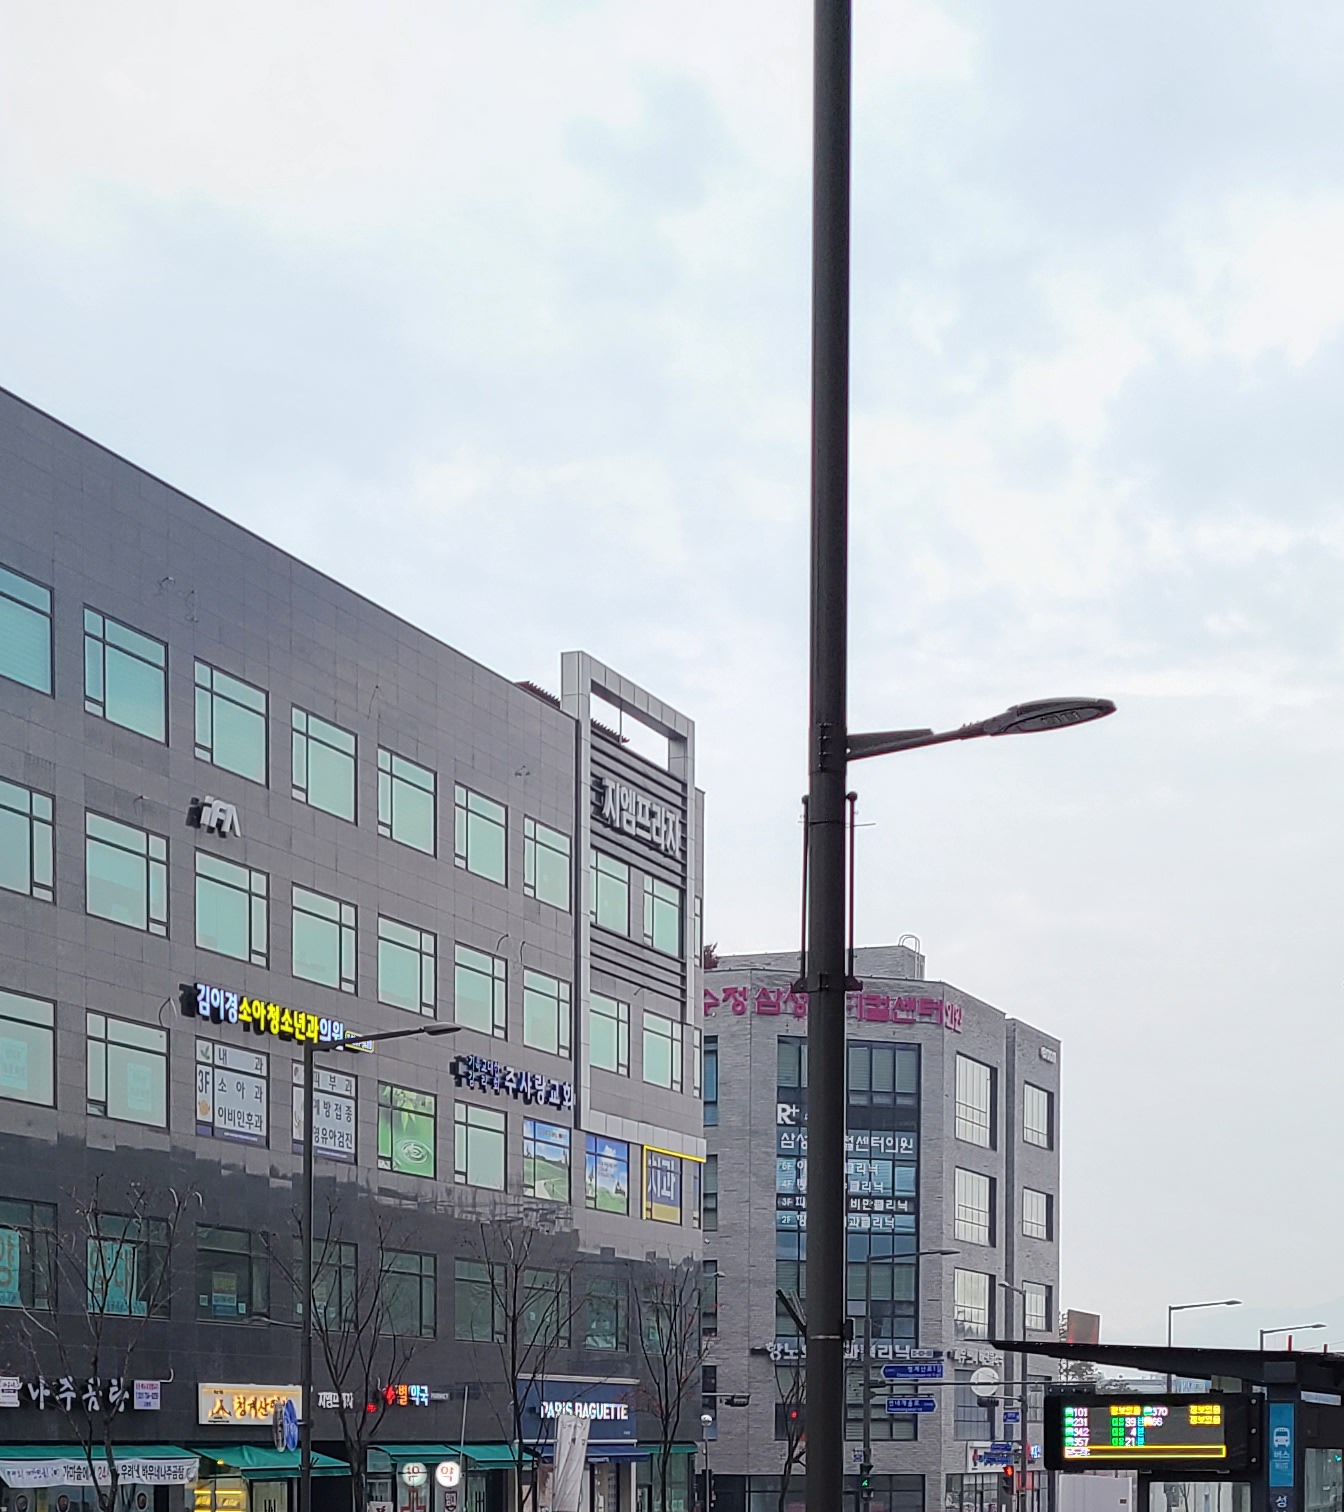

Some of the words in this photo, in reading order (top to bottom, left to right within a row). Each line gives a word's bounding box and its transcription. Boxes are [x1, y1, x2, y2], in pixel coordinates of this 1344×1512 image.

[602, 779, 681, 857] 지엠프라자
[197, 983, 344, 1044] 김이경소아청소년과의원
[198, 1070, 211, 1096] 3F
[505, 1066, 574, 1107] 주사랑교회
[217, 1106, 264, 1132] 이비인후과
[647, 1158, 676, 1201] 치과
[27, 1375, 130, 1413] 나주곰탕
[575, 1401, 629, 1420] BAGUETTE
[1073, 1407, 1088, 1417] 101
